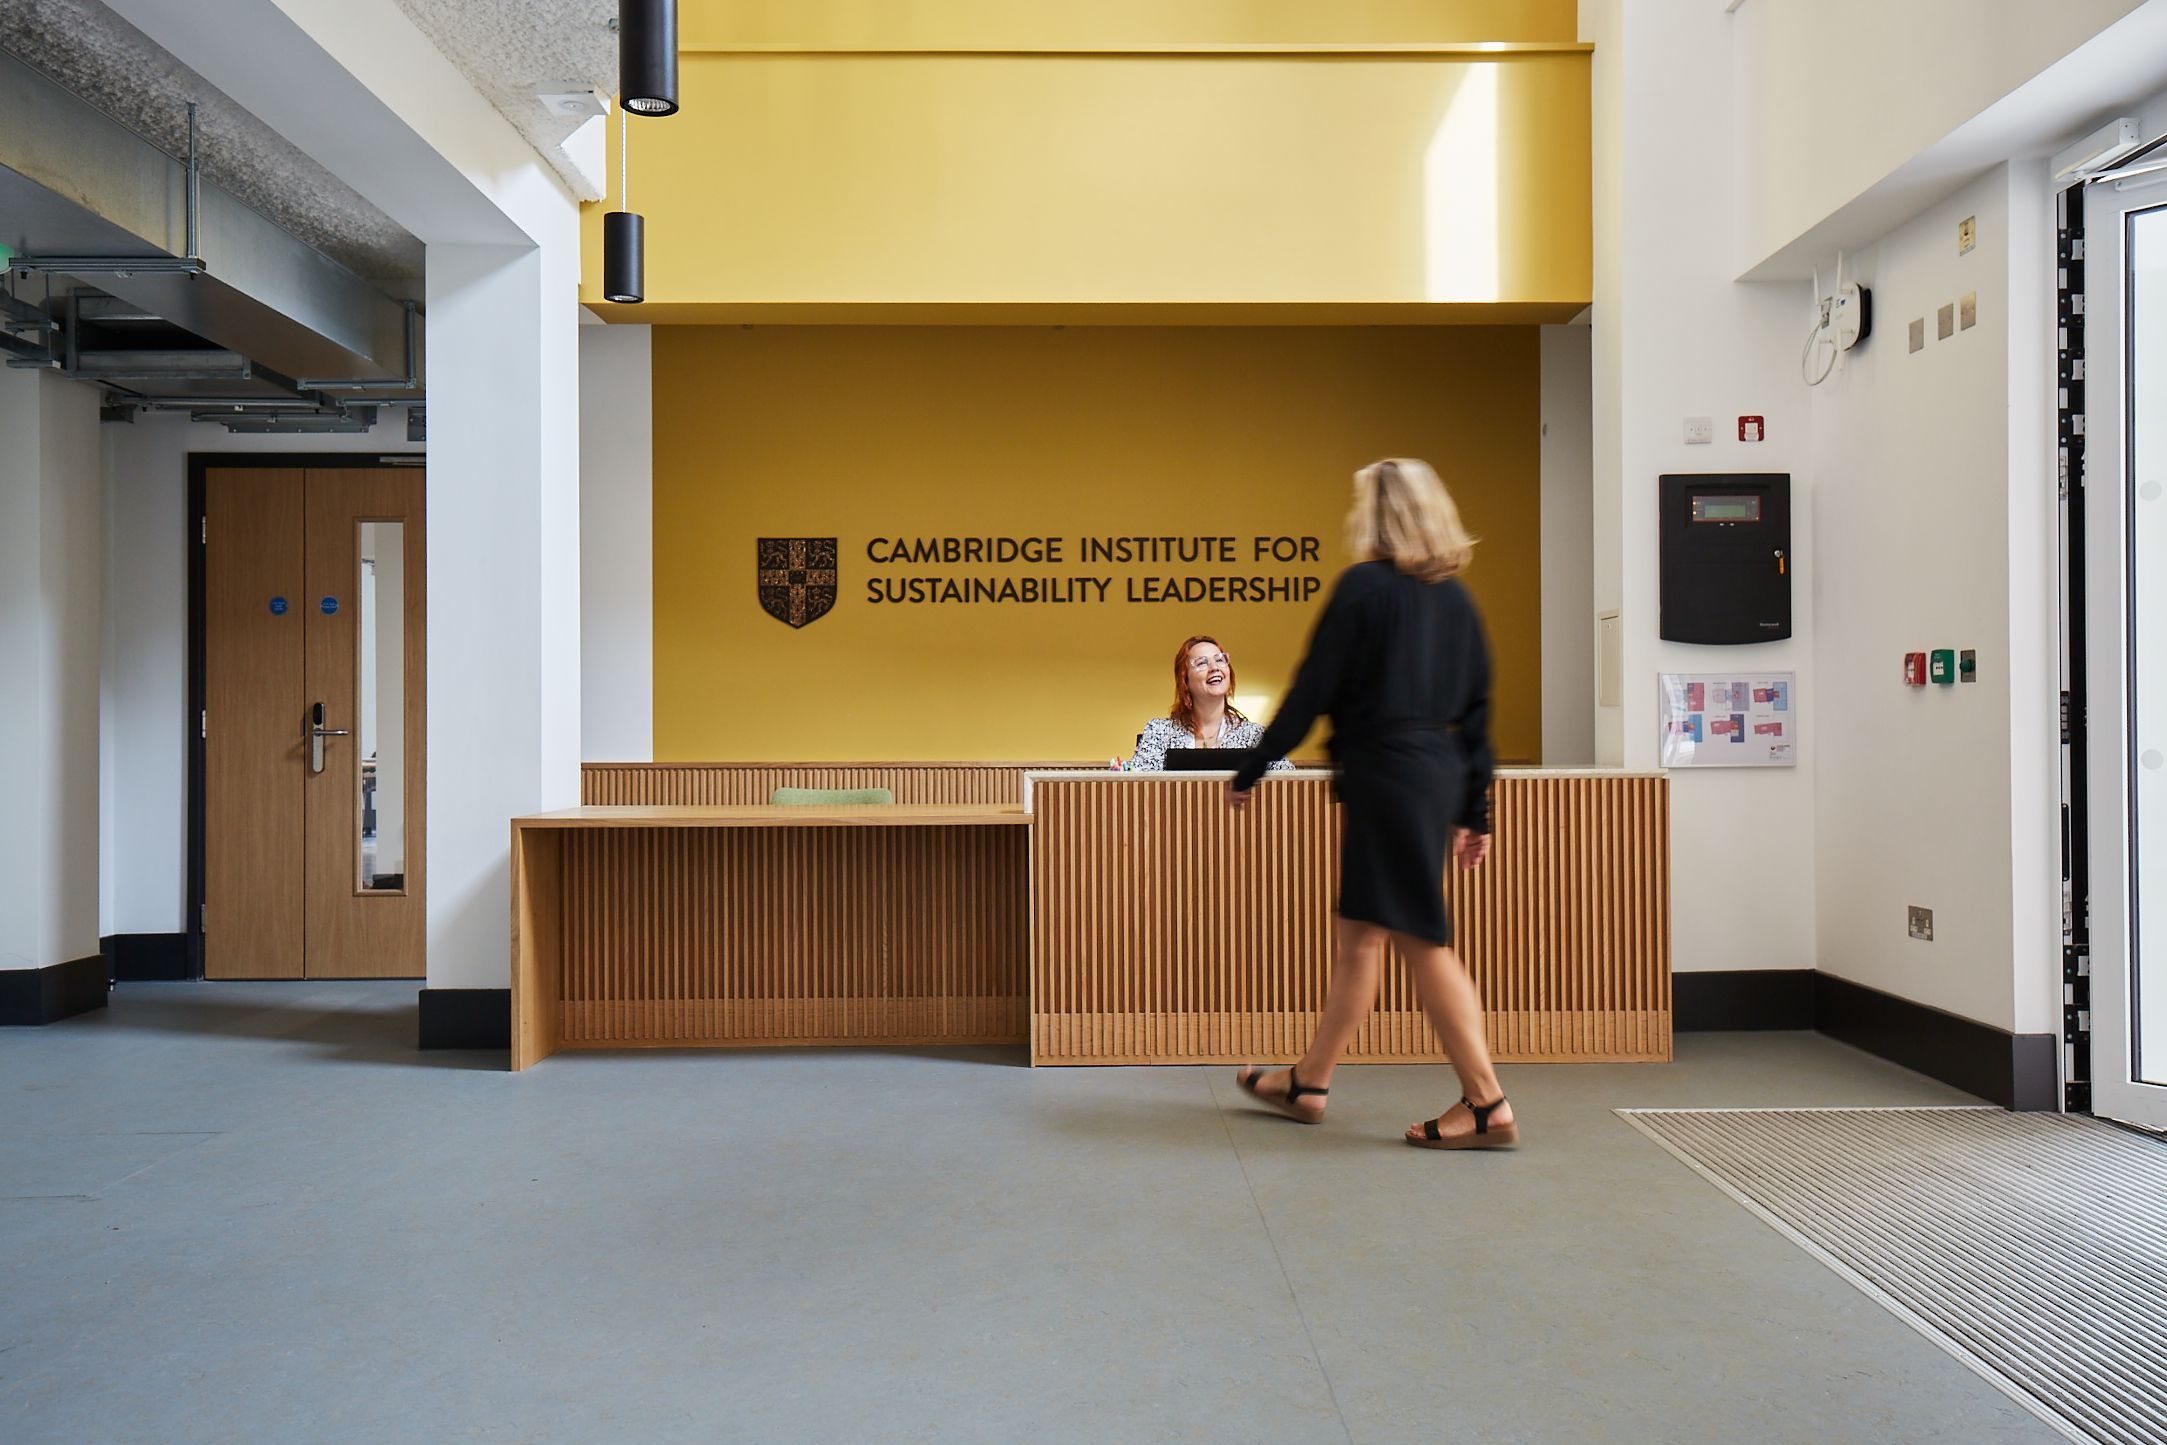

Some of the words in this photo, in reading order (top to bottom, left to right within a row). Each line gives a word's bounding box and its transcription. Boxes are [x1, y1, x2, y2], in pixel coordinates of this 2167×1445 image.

[866, 537, 1063, 563] CAMBRIDGE
[1081, 537, 1236, 563] INSTITUTE
[1254, 536, 1320, 562] FOR
[866, 577, 1112, 603] SUSTAINABILITY
[1127, 577, 1321, 603] LEADERSHIP
